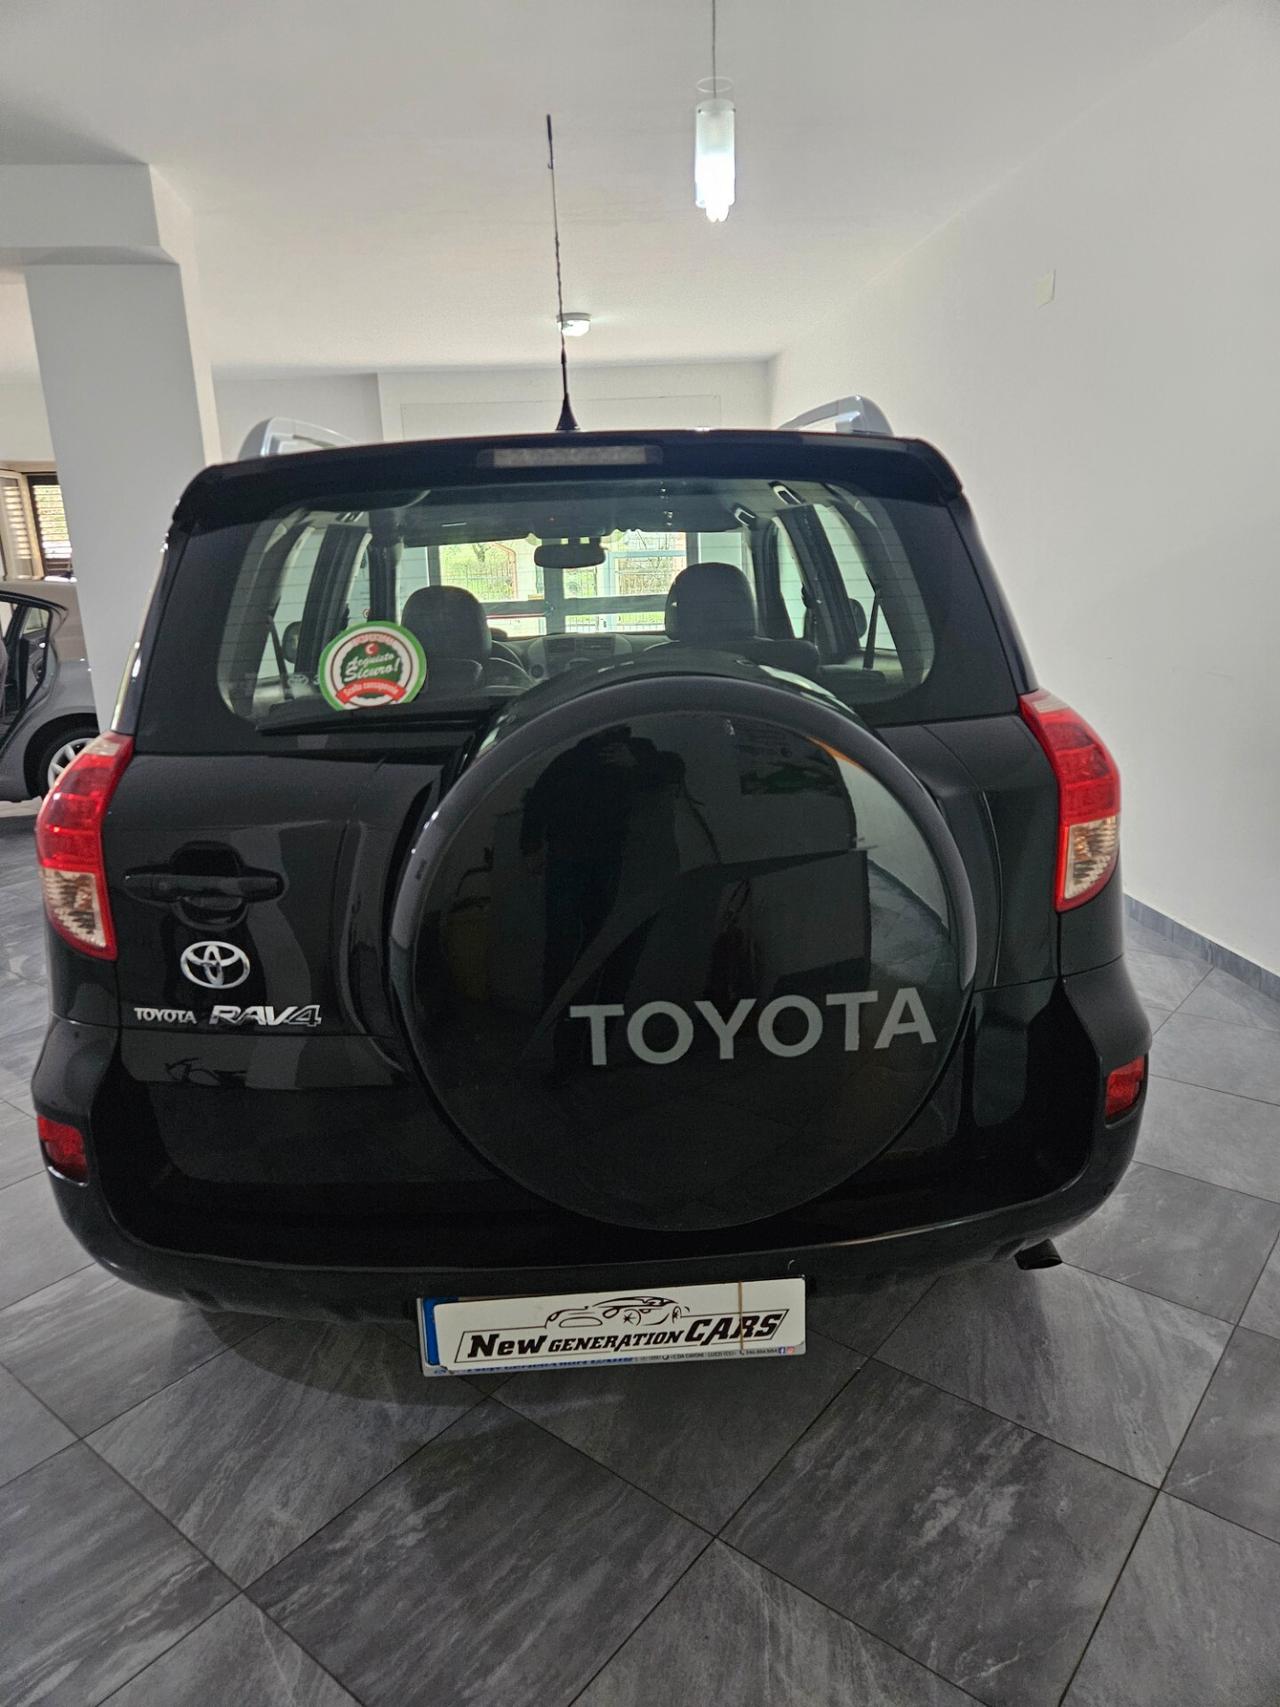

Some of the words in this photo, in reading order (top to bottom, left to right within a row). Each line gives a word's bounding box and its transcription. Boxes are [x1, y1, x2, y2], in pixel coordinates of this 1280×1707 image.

[343, 657, 401, 682] Sicuro!
[133, 1006, 197, 1025] TOYOTA
[208, 1004, 322, 1027] RAV4
[569, 986, 938, 1066] TOYOTA
[548, 1330, 685, 1352] GENERATION
[684, 1313, 783, 1346] CARS
